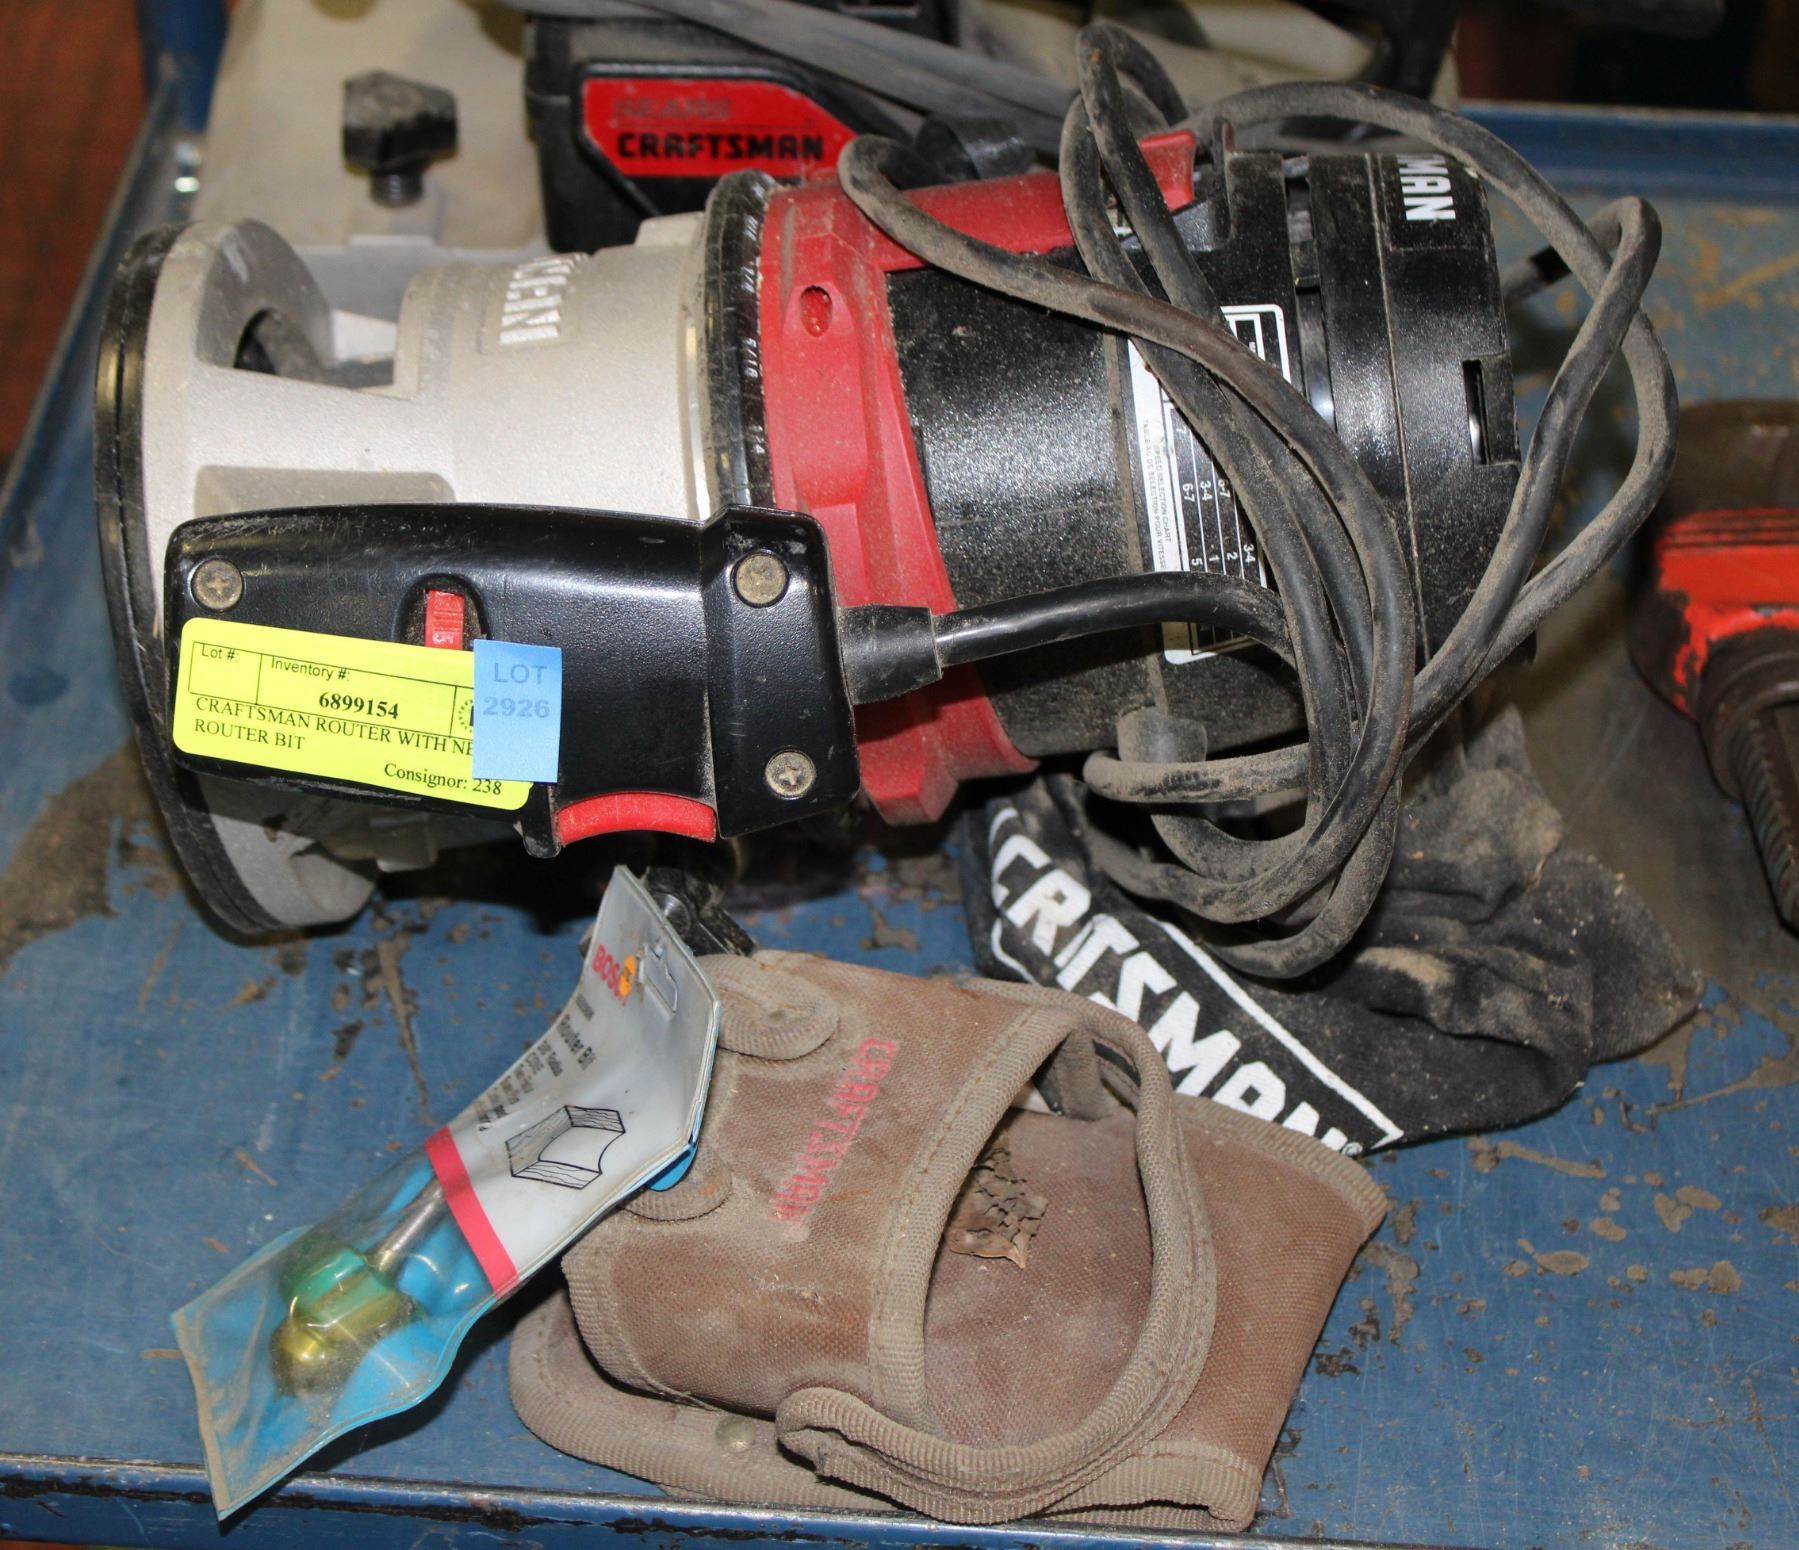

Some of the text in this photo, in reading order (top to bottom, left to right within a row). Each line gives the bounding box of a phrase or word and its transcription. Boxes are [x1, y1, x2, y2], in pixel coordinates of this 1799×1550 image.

[617, 133, 824, 160] CRAFTSMAN
[1157, 472, 1168, 515] SELECTION
[1163, 516, 1172, 542] CHART
[1200, 481, 1220, 562] 3-4 1
[1182, 483, 1195, 502] 6-7
[1191, 557, 1203, 566] 5
[1157, 538, 1167, 569] VITESSE
[1227, 552, 1238, 560] 2
[1243, 544, 1256, 562] 3-4
[201, 645, 225, 661] Lot
[271, 656, 335, 681] Inventory
[494, 662, 548, 684] LOT
[318, 691, 400, 720] 6899154
[482, 697, 551, 719] 2926
[194, 717, 306, 750] ROUTER BIT
[195, 696, 311, 729] CRAFTSMAN
[316, 716, 391, 743] ROUTER
[398, 730, 448, 752] WITH
[384, 762, 502, 796] Consignor: 238
